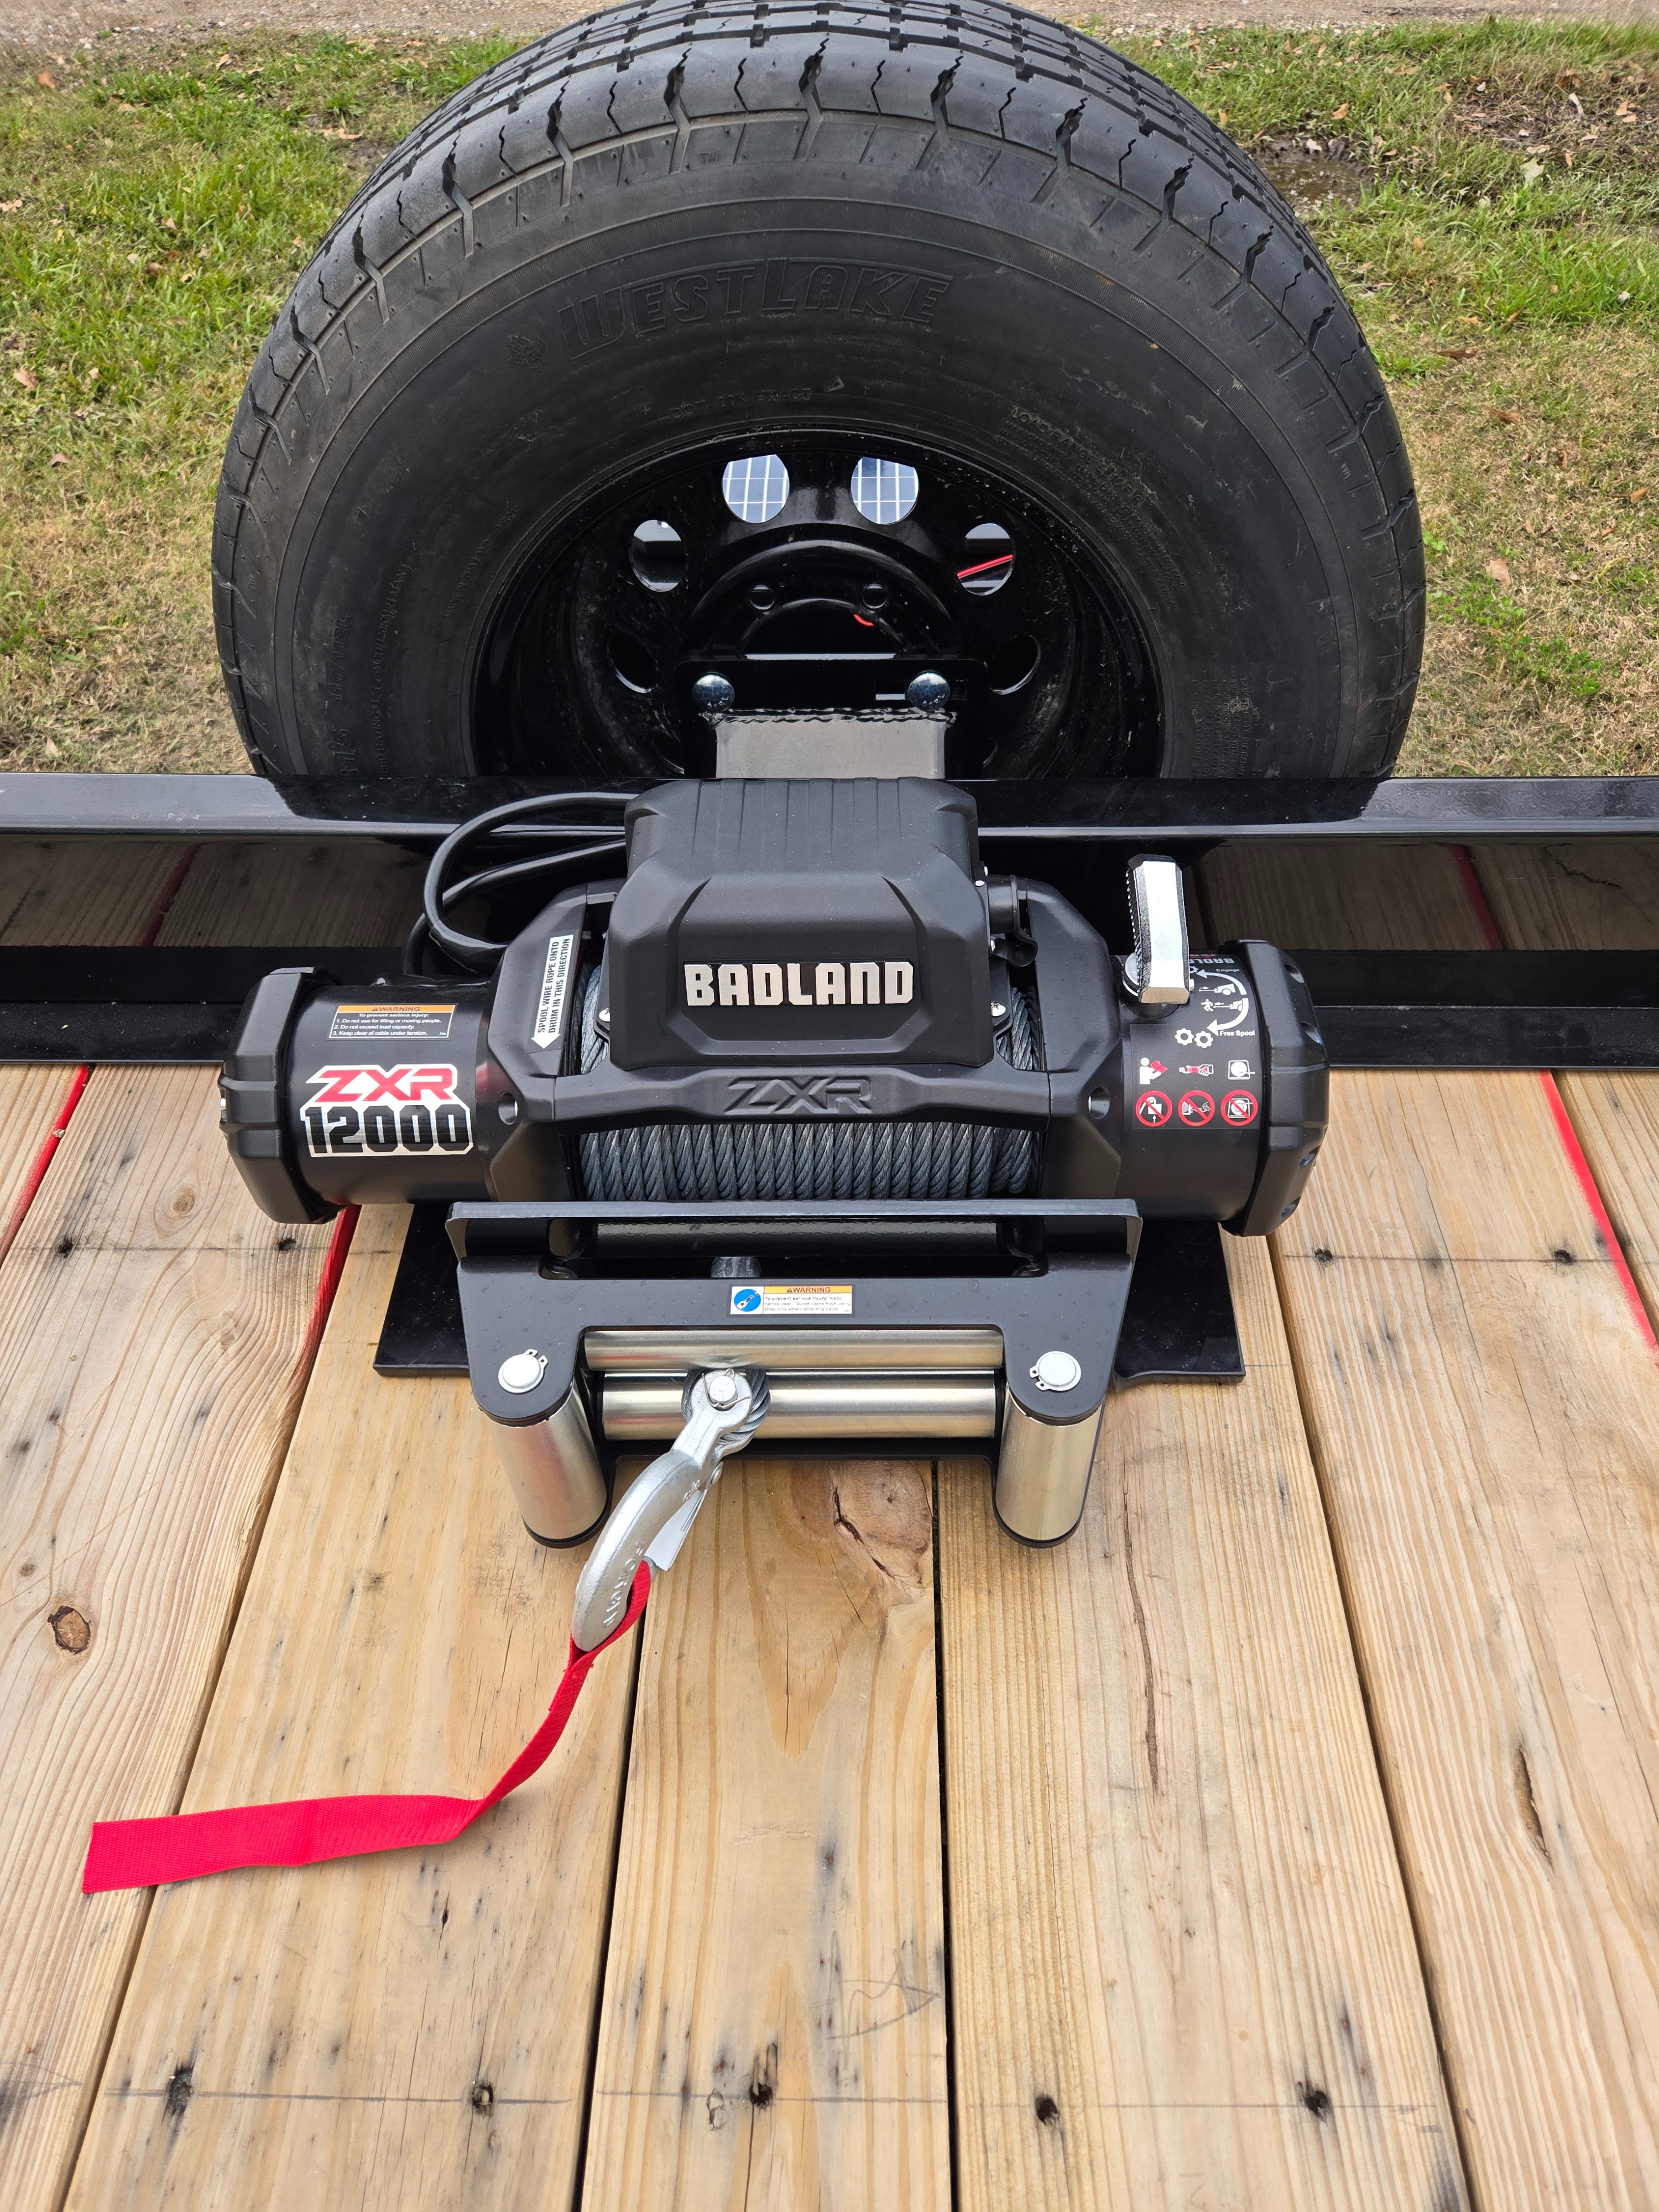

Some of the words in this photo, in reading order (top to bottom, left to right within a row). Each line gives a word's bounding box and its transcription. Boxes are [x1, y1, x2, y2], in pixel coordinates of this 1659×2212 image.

[557, 258, 953, 361] WESTLAKE
[550, 942, 559, 961] ONTO
[557, 938, 570, 978] DIRECTION
[546, 963, 556, 983] ROPE
[684, 962, 914, 1006] BADLAND
[542, 985, 552, 1006] WIRE
[554, 979, 564, 998] THIS
[552, 999, 561, 1007] IN
[538, 1007, 549, 1033] SPOOL
[548, 1009, 559, 1034] DRUM
[313, 1068, 453, 1103] ZXR
[724, 1076, 873, 1114] ZXR
[305, 1104, 469, 1154] 12000
